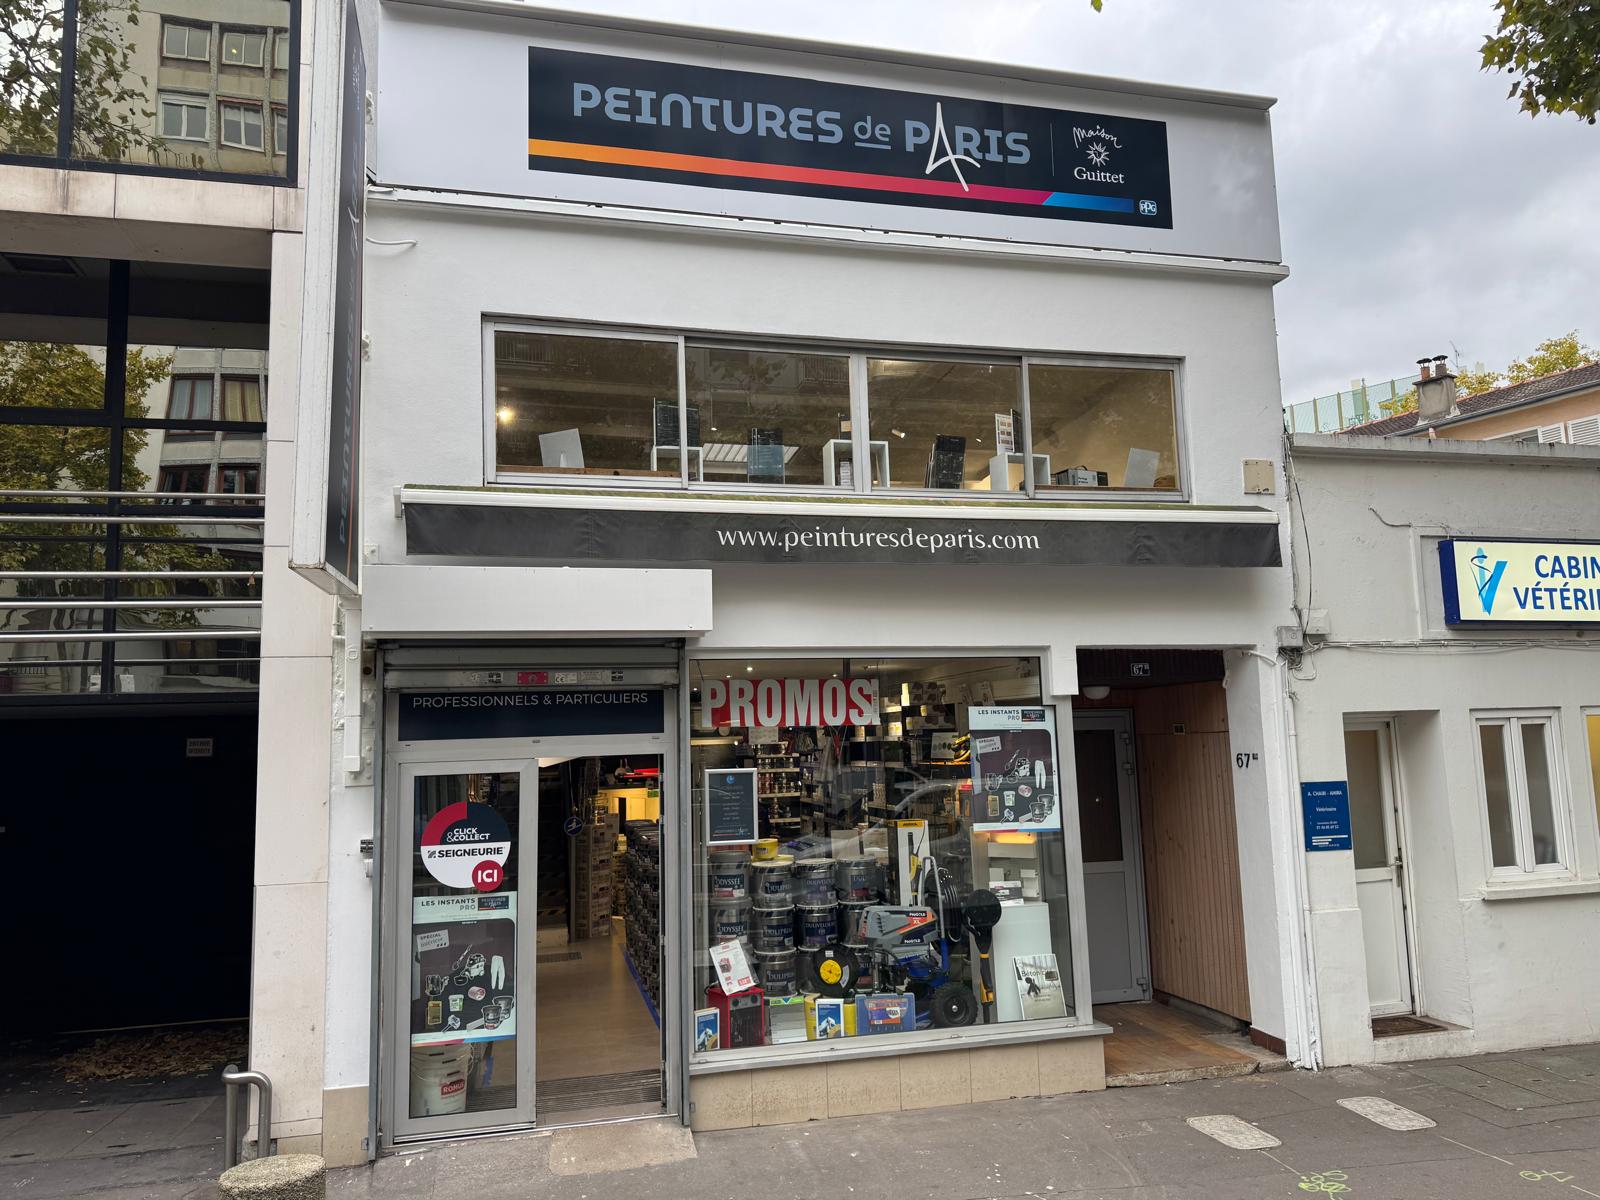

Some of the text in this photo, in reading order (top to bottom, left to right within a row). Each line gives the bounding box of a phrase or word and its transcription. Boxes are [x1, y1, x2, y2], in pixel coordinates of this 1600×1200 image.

[573, 82, 1031, 192] PEINTURES de PARIS
[1072, 125, 1122, 149] Maison
[1073, 166, 1125, 184] Guittet
[716, 527, 1040, 554] www.peinturesdeparis.com
[1513, 581, 1600, 610] VÉTÉRI
[413, 692, 648, 709] PROFESSIONNELS & PARTICULIERS
[702, 678, 873, 727] PROMOS
[453, 827, 478, 835] CLICK
[453, 833, 490, 842] COLLECT
[437, 846, 504, 858] SEIGNEURIE
[477, 869, 498, 883] ICI
[437, 897, 476, 906] INSTANTS
